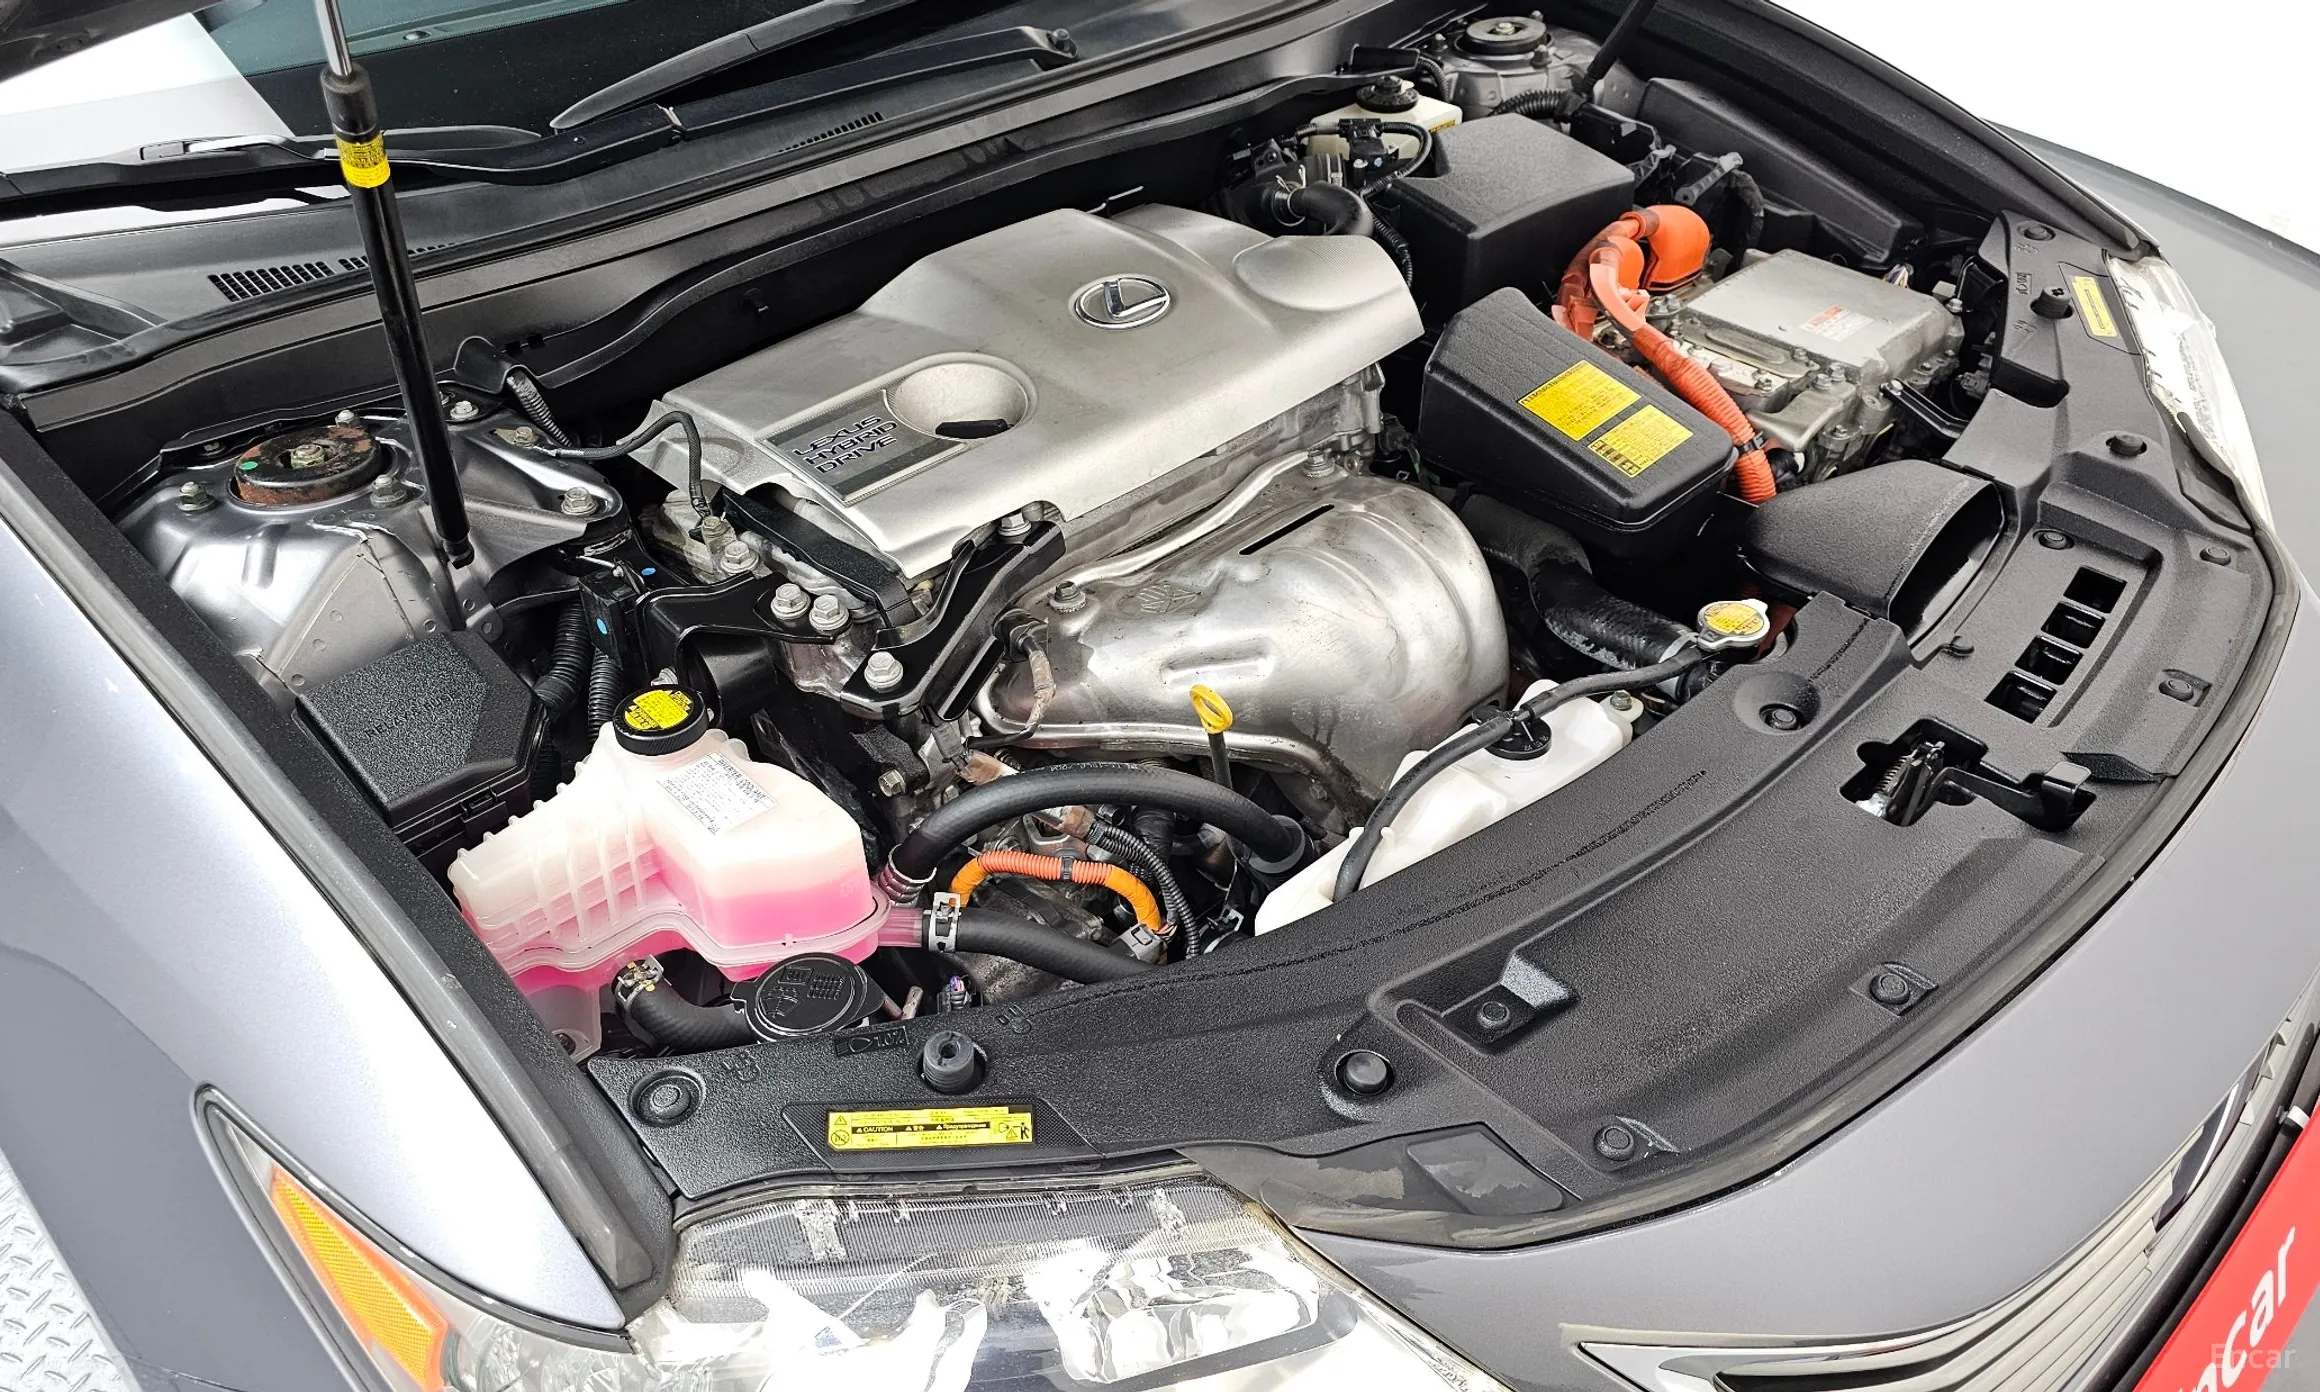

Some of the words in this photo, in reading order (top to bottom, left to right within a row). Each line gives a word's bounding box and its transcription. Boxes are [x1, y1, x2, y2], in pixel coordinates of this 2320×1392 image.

[792, 414, 883, 456] LEXUS
[803, 420, 898, 465] HYBRID
[814, 434, 897, 474] DRIVE
[863, 1125, 894, 1133] CAUTION
